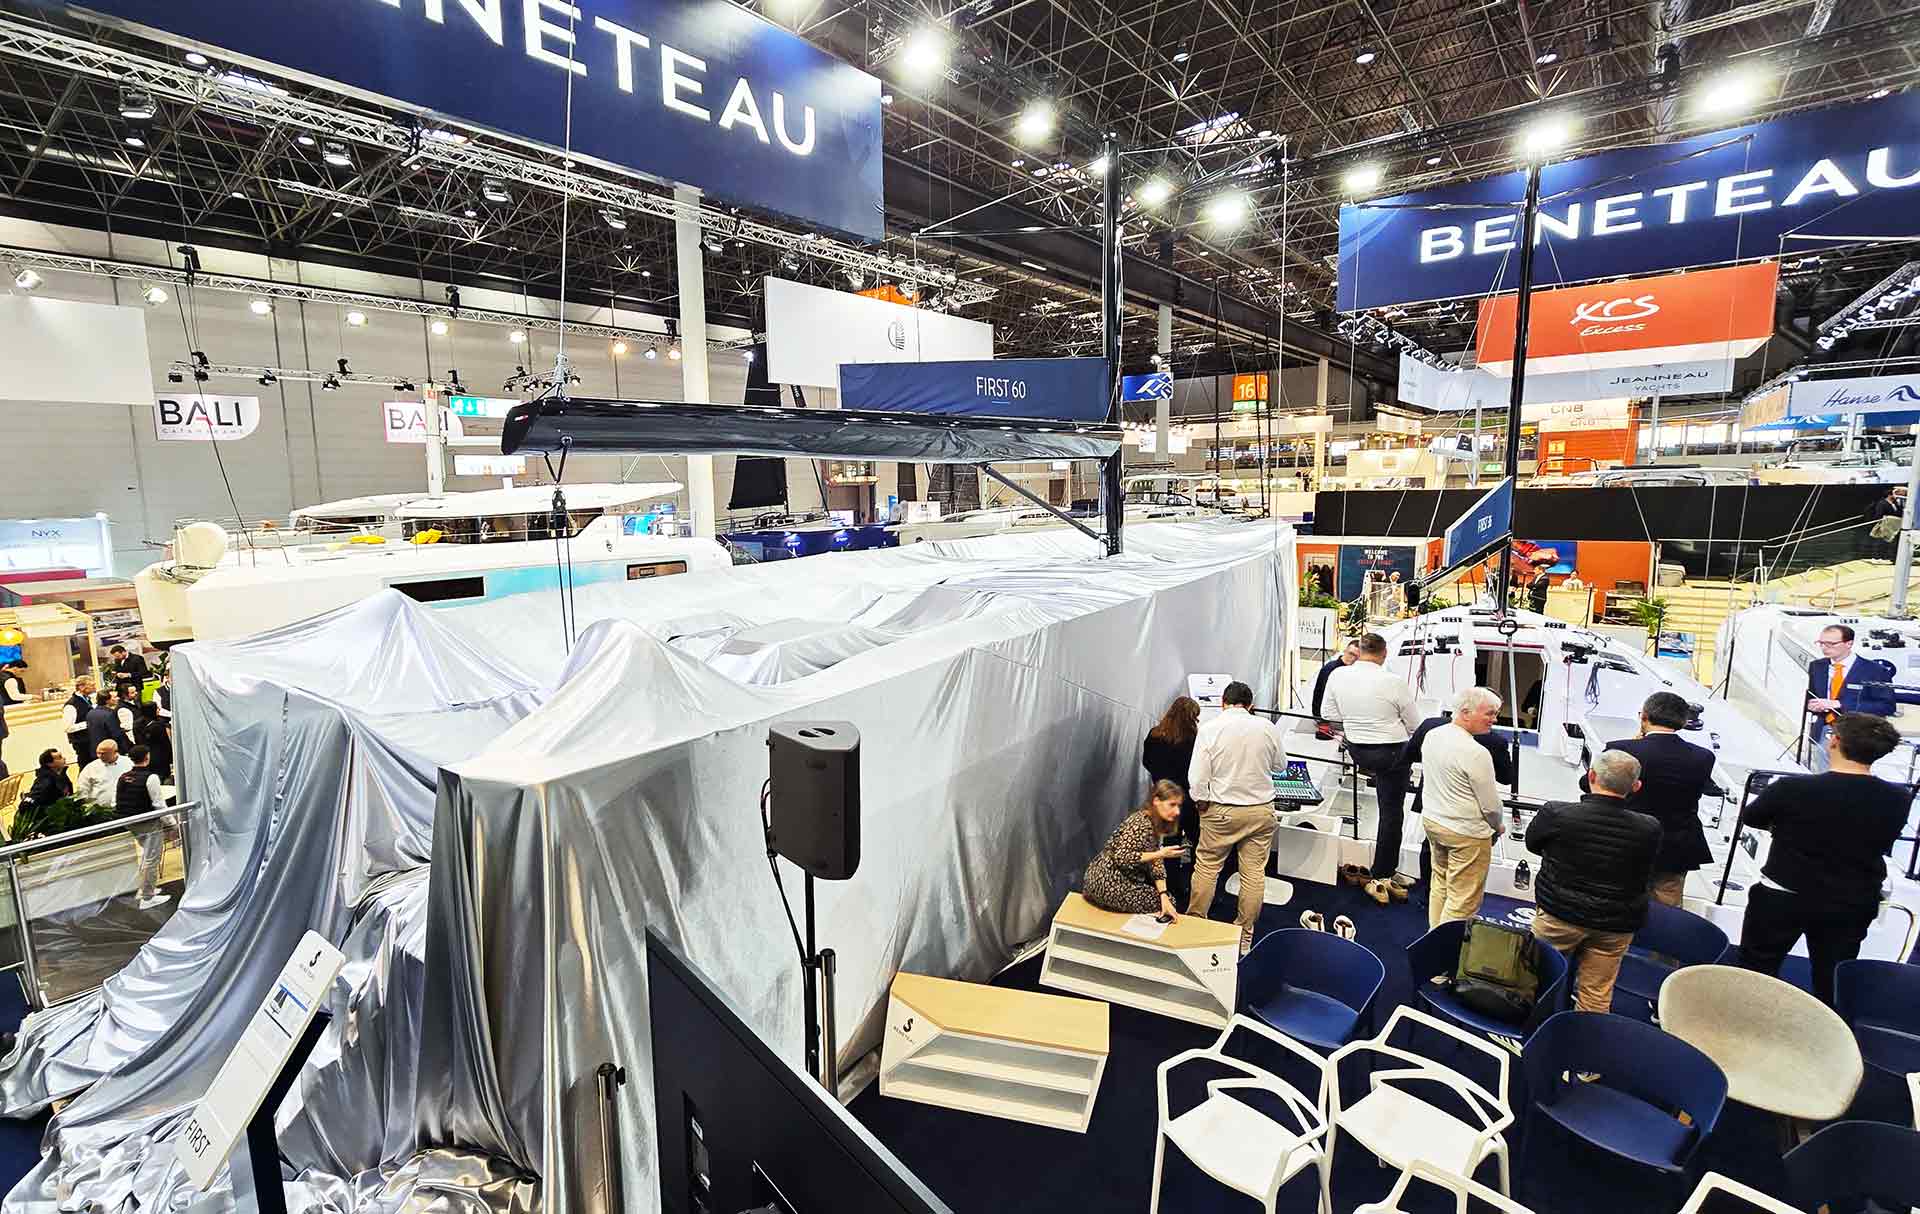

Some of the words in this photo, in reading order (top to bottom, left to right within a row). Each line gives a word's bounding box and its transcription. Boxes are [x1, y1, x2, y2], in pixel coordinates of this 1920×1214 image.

[1580, 323, 1648, 336] Excess
[976, 376, 1009, 398] FIRST
[1012, 380, 1026, 399] 60
[1609, 371, 1709, 385] JEANNEAU
[1635, 383, 1681, 392] YACHTS
[1239, 383, 1256, 399] 16
[1823, 388, 1881, 408] Hanse
[158, 399, 242, 426] BALI
[388, 408, 449, 431] BAI
[184, 1118, 211, 1159] FIRST
